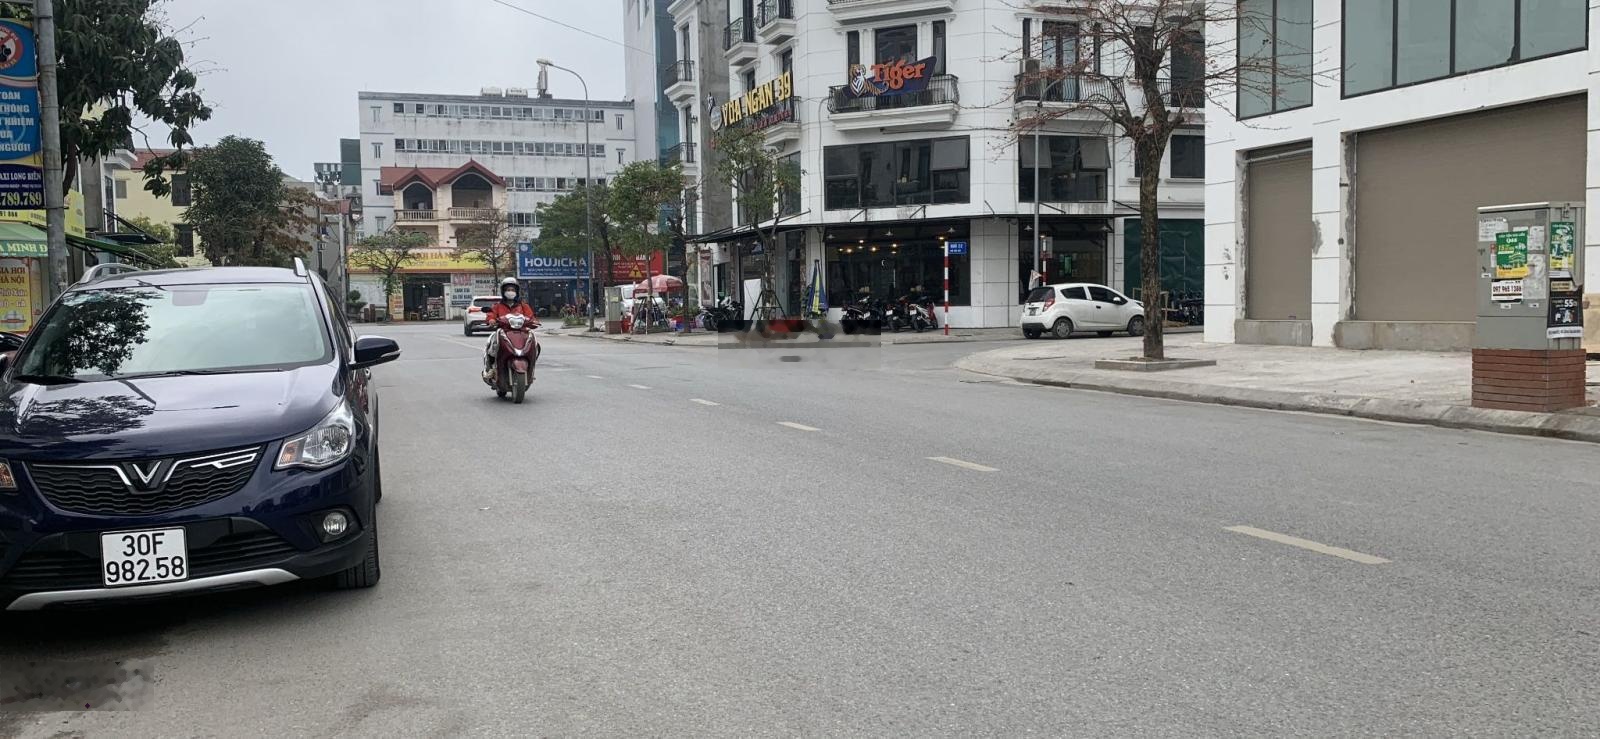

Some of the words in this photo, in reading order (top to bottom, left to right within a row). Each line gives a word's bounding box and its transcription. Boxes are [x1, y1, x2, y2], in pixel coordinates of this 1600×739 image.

[871, 59, 926, 90] Tiger
[745, 81, 774, 116] NGAN
[777, 71, 791, 101] 39
[11, 172, 26, 180] LONG
[7, 243, 38, 253] MINH
[525, 257, 587, 267] HOUJICHA
[121, 532, 165, 557] 30F
[106, 556, 185, 583] 982.58
